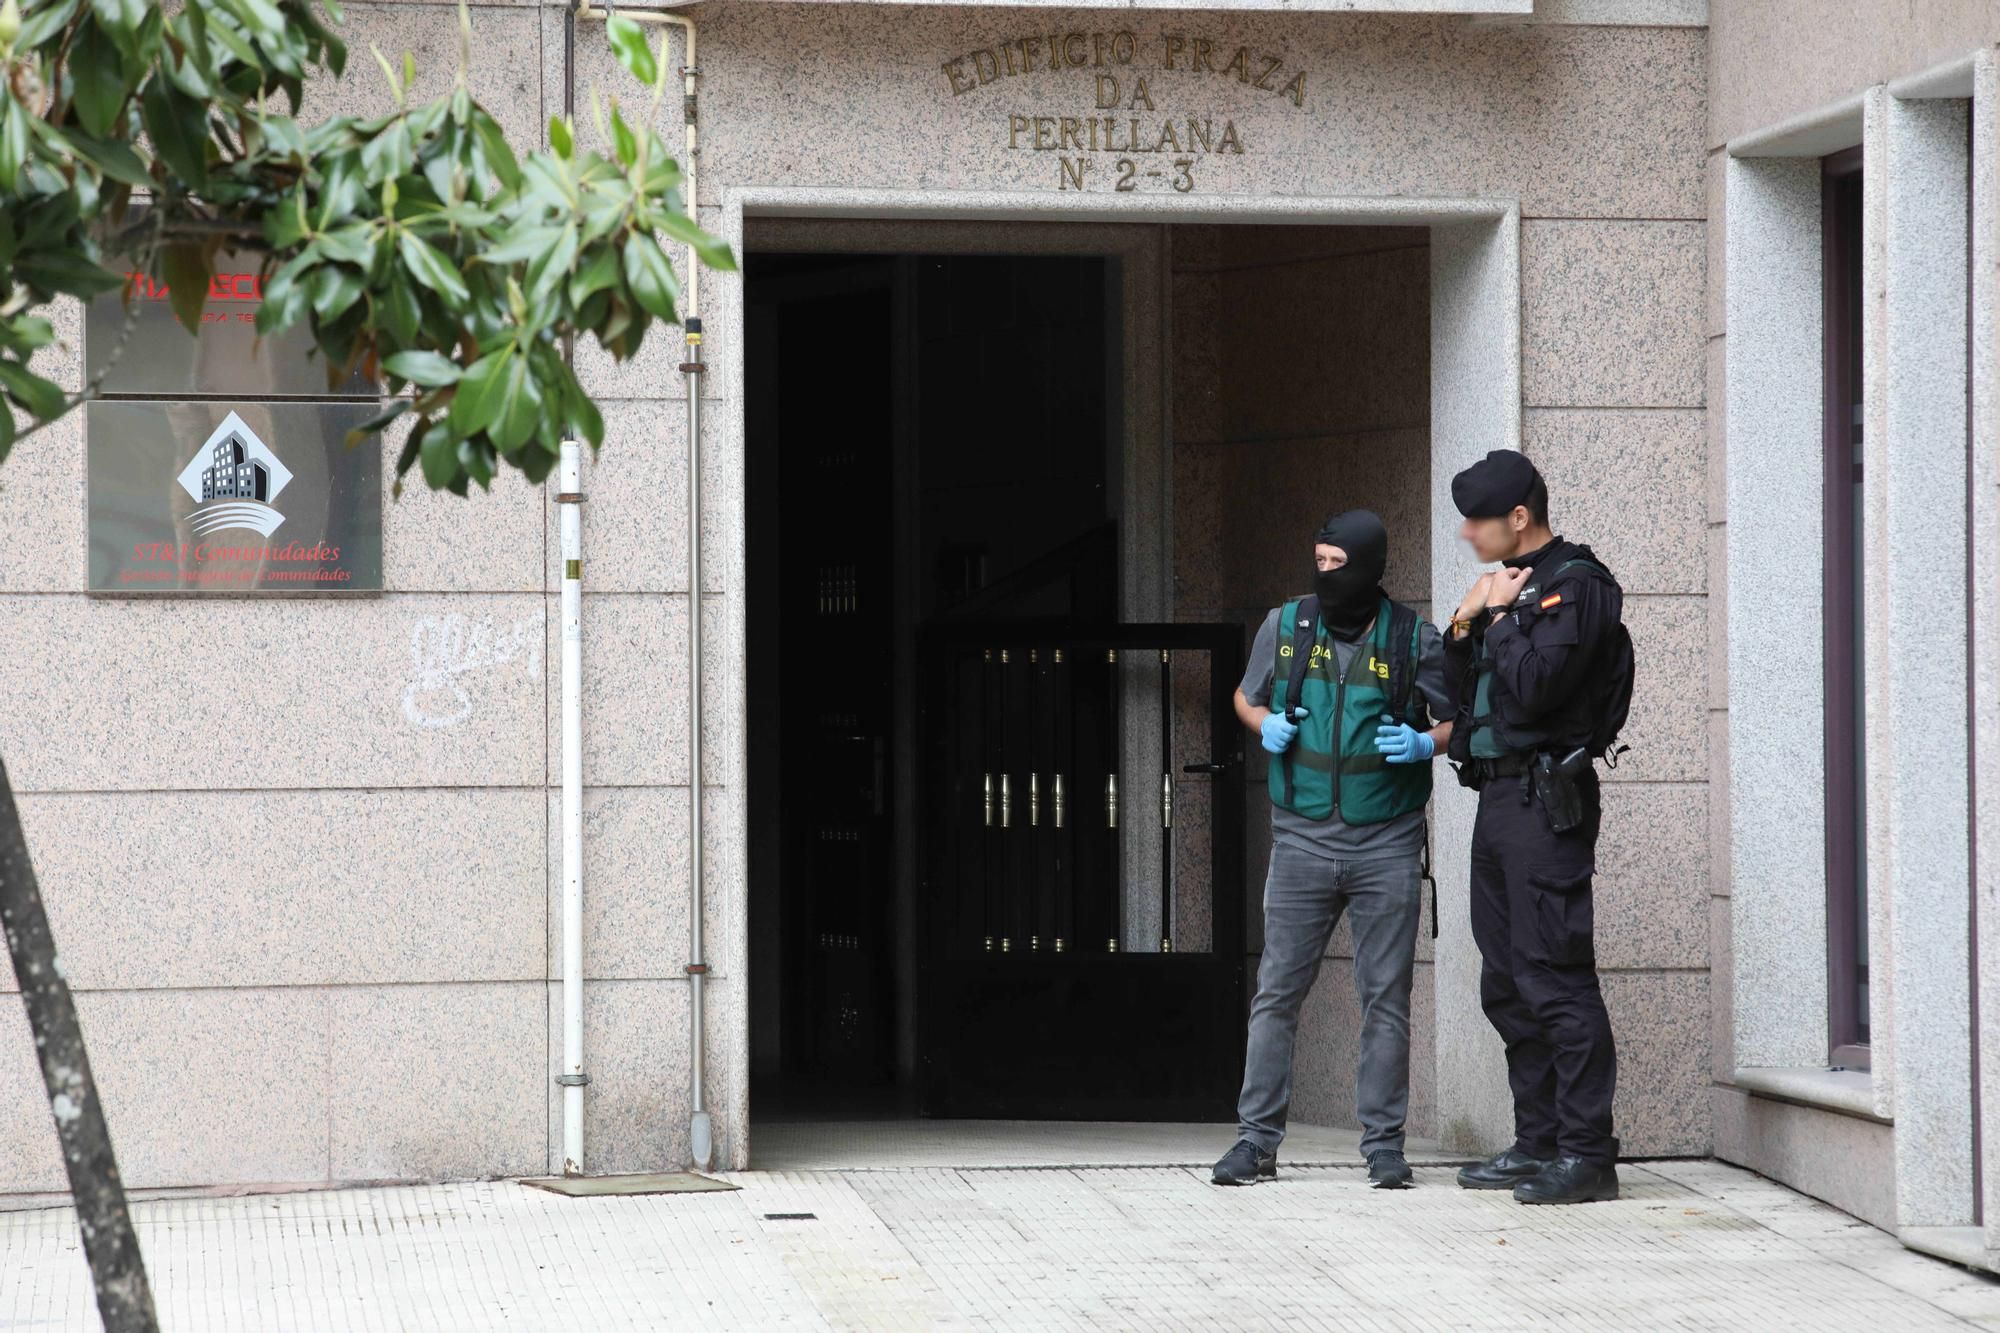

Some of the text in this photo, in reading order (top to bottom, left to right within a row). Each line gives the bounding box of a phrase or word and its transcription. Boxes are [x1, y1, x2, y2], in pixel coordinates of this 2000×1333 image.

[941, 30, 1308, 107] EDIFICIO PRAZA
[1094, 74, 1155, 111] DA
[1007, 113, 1244, 155] PERILLANA
[194, 540, 341, 561] Comunidades
